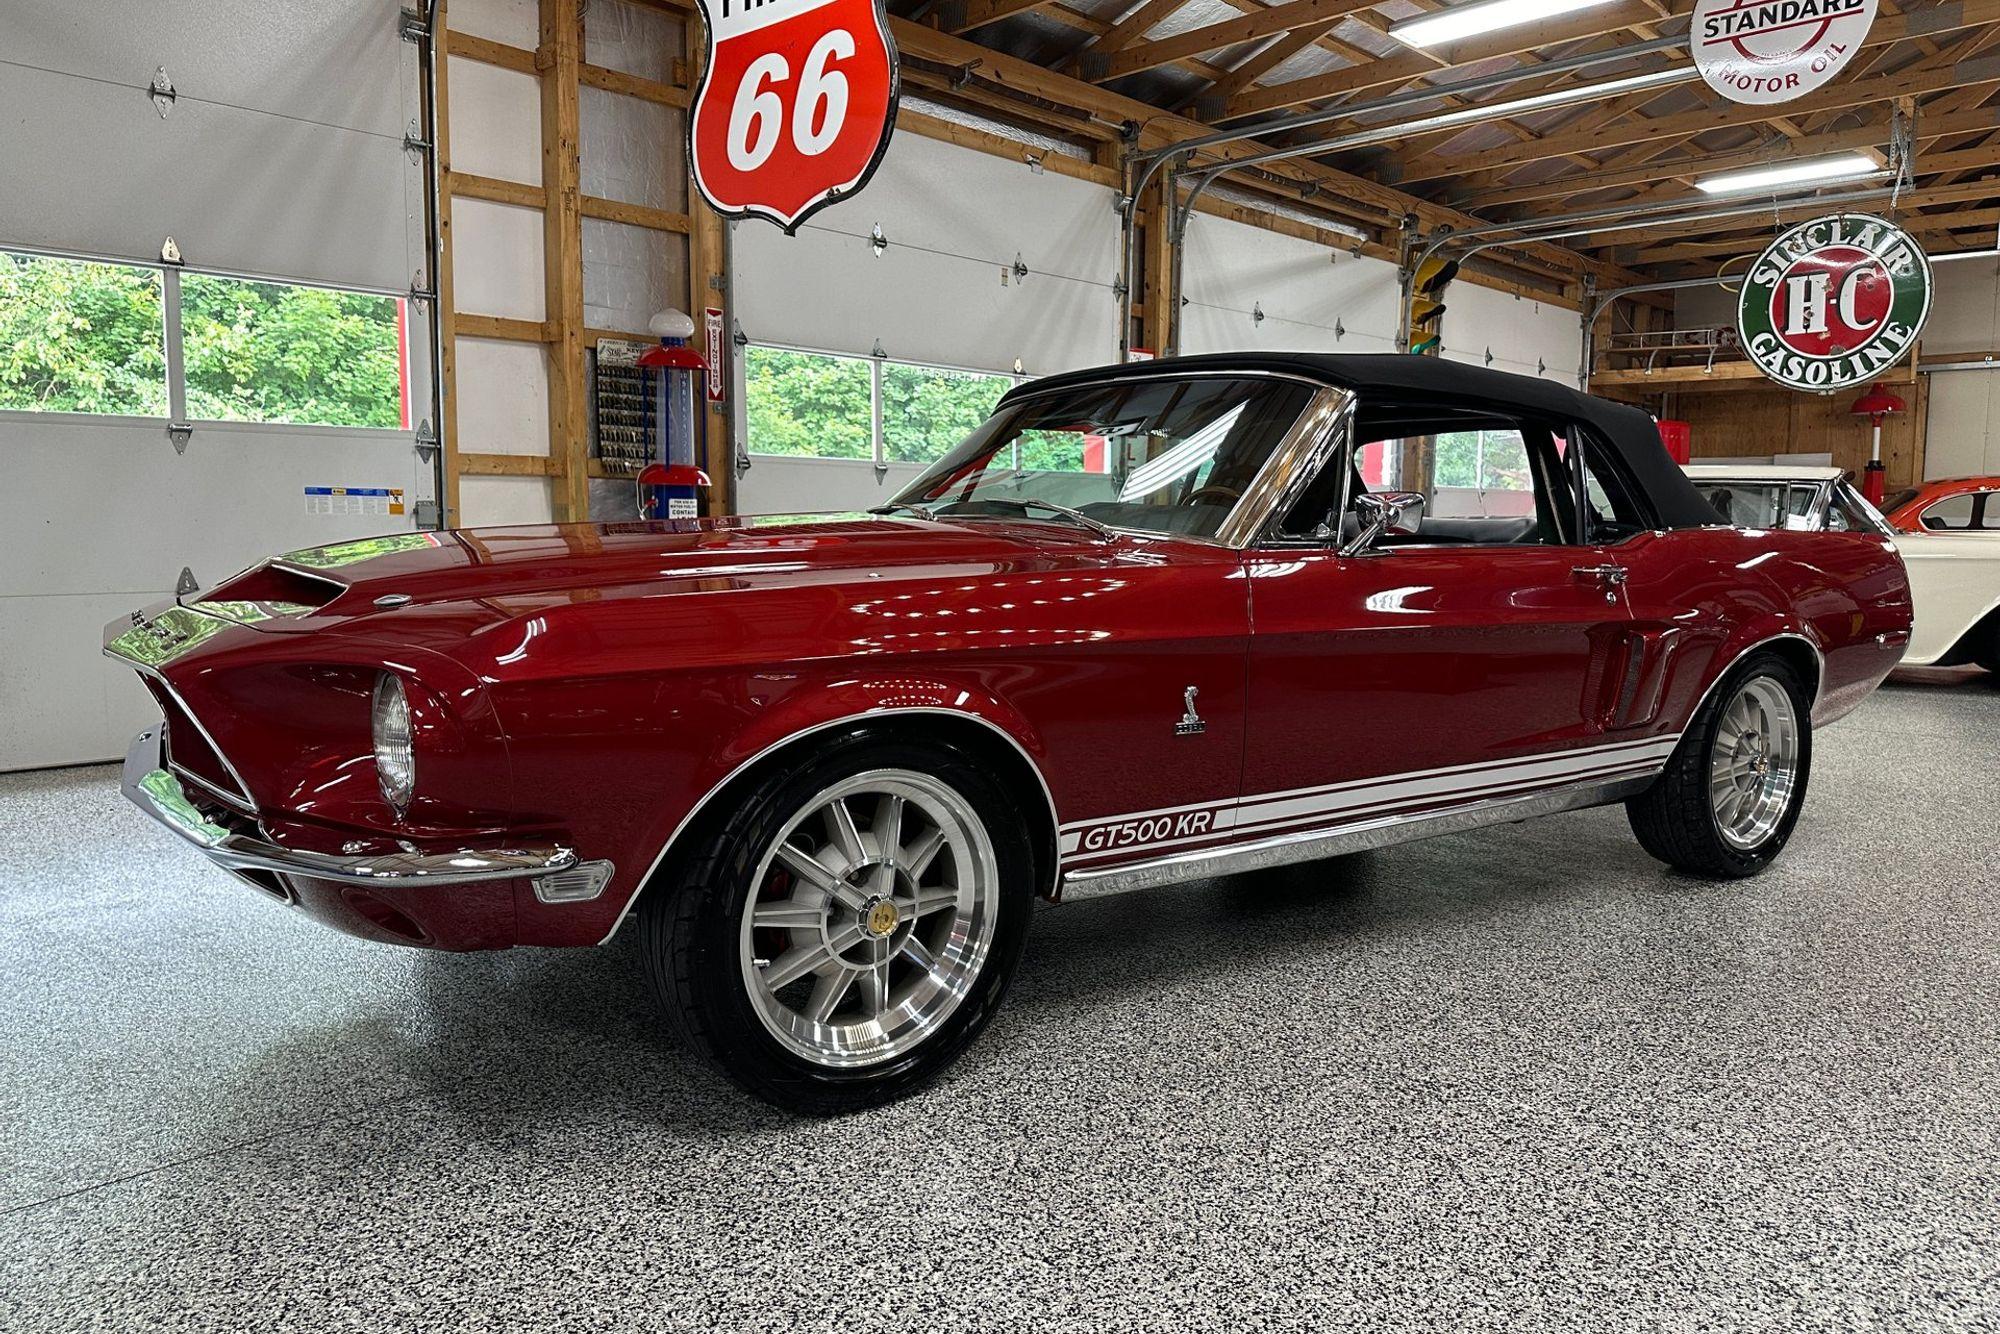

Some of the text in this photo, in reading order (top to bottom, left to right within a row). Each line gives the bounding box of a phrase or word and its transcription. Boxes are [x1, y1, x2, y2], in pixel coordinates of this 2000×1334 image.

[1718, 43, 1847, 93] MOTOR OIL
[727, 29, 856, 172] 66
[1753, 222, 1913, 288] SINCLAIR
[708, 319, 721, 328] FIRE
[1784, 266, 1878, 335] H-C
[1751, 321, 1913, 385] GASOLINE
[1084, 811, 1211, 850] GT500 KR
